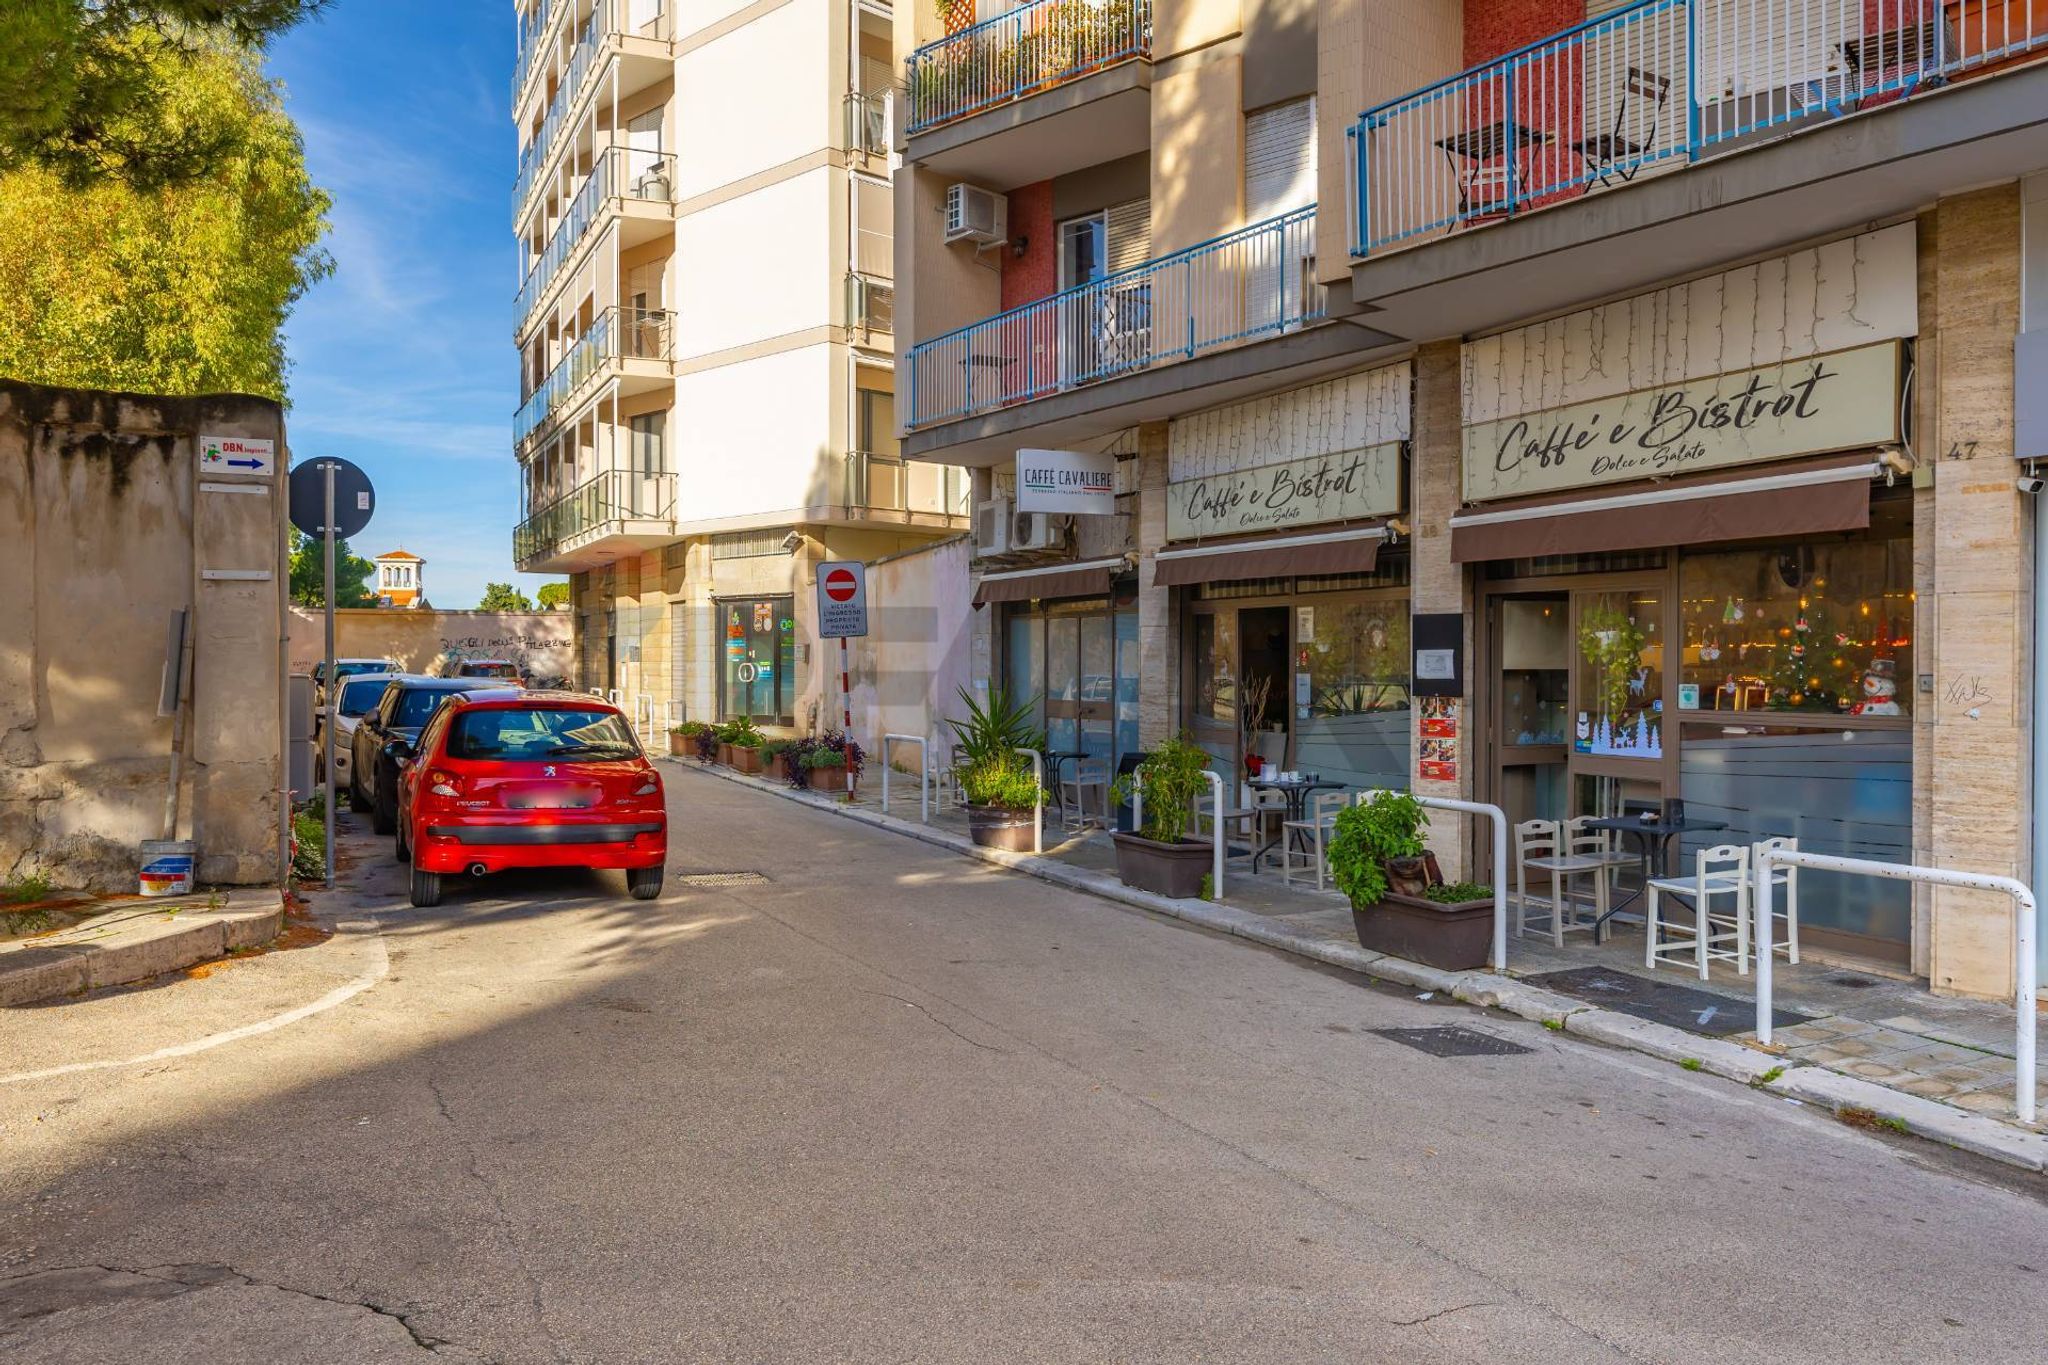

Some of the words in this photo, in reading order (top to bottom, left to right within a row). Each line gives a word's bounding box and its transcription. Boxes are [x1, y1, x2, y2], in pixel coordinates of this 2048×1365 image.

[1608, 423, 1636, 444] e
[1638, 362, 1840, 449] Bistrot
[222, 442, 243, 453] DBN
[1946, 441, 1978, 460] 47
[1590, 454, 1638, 476] Dolce
[1639, 457, 1651, 466] e
[1652, 441, 1706, 469] Salato
[1058, 470, 1112, 487] CAVALIERE
[1249, 489, 1264, 504] e
[1265, 455, 1366, 509] Bistrot
[1271, 506, 1300, 524] Salato
